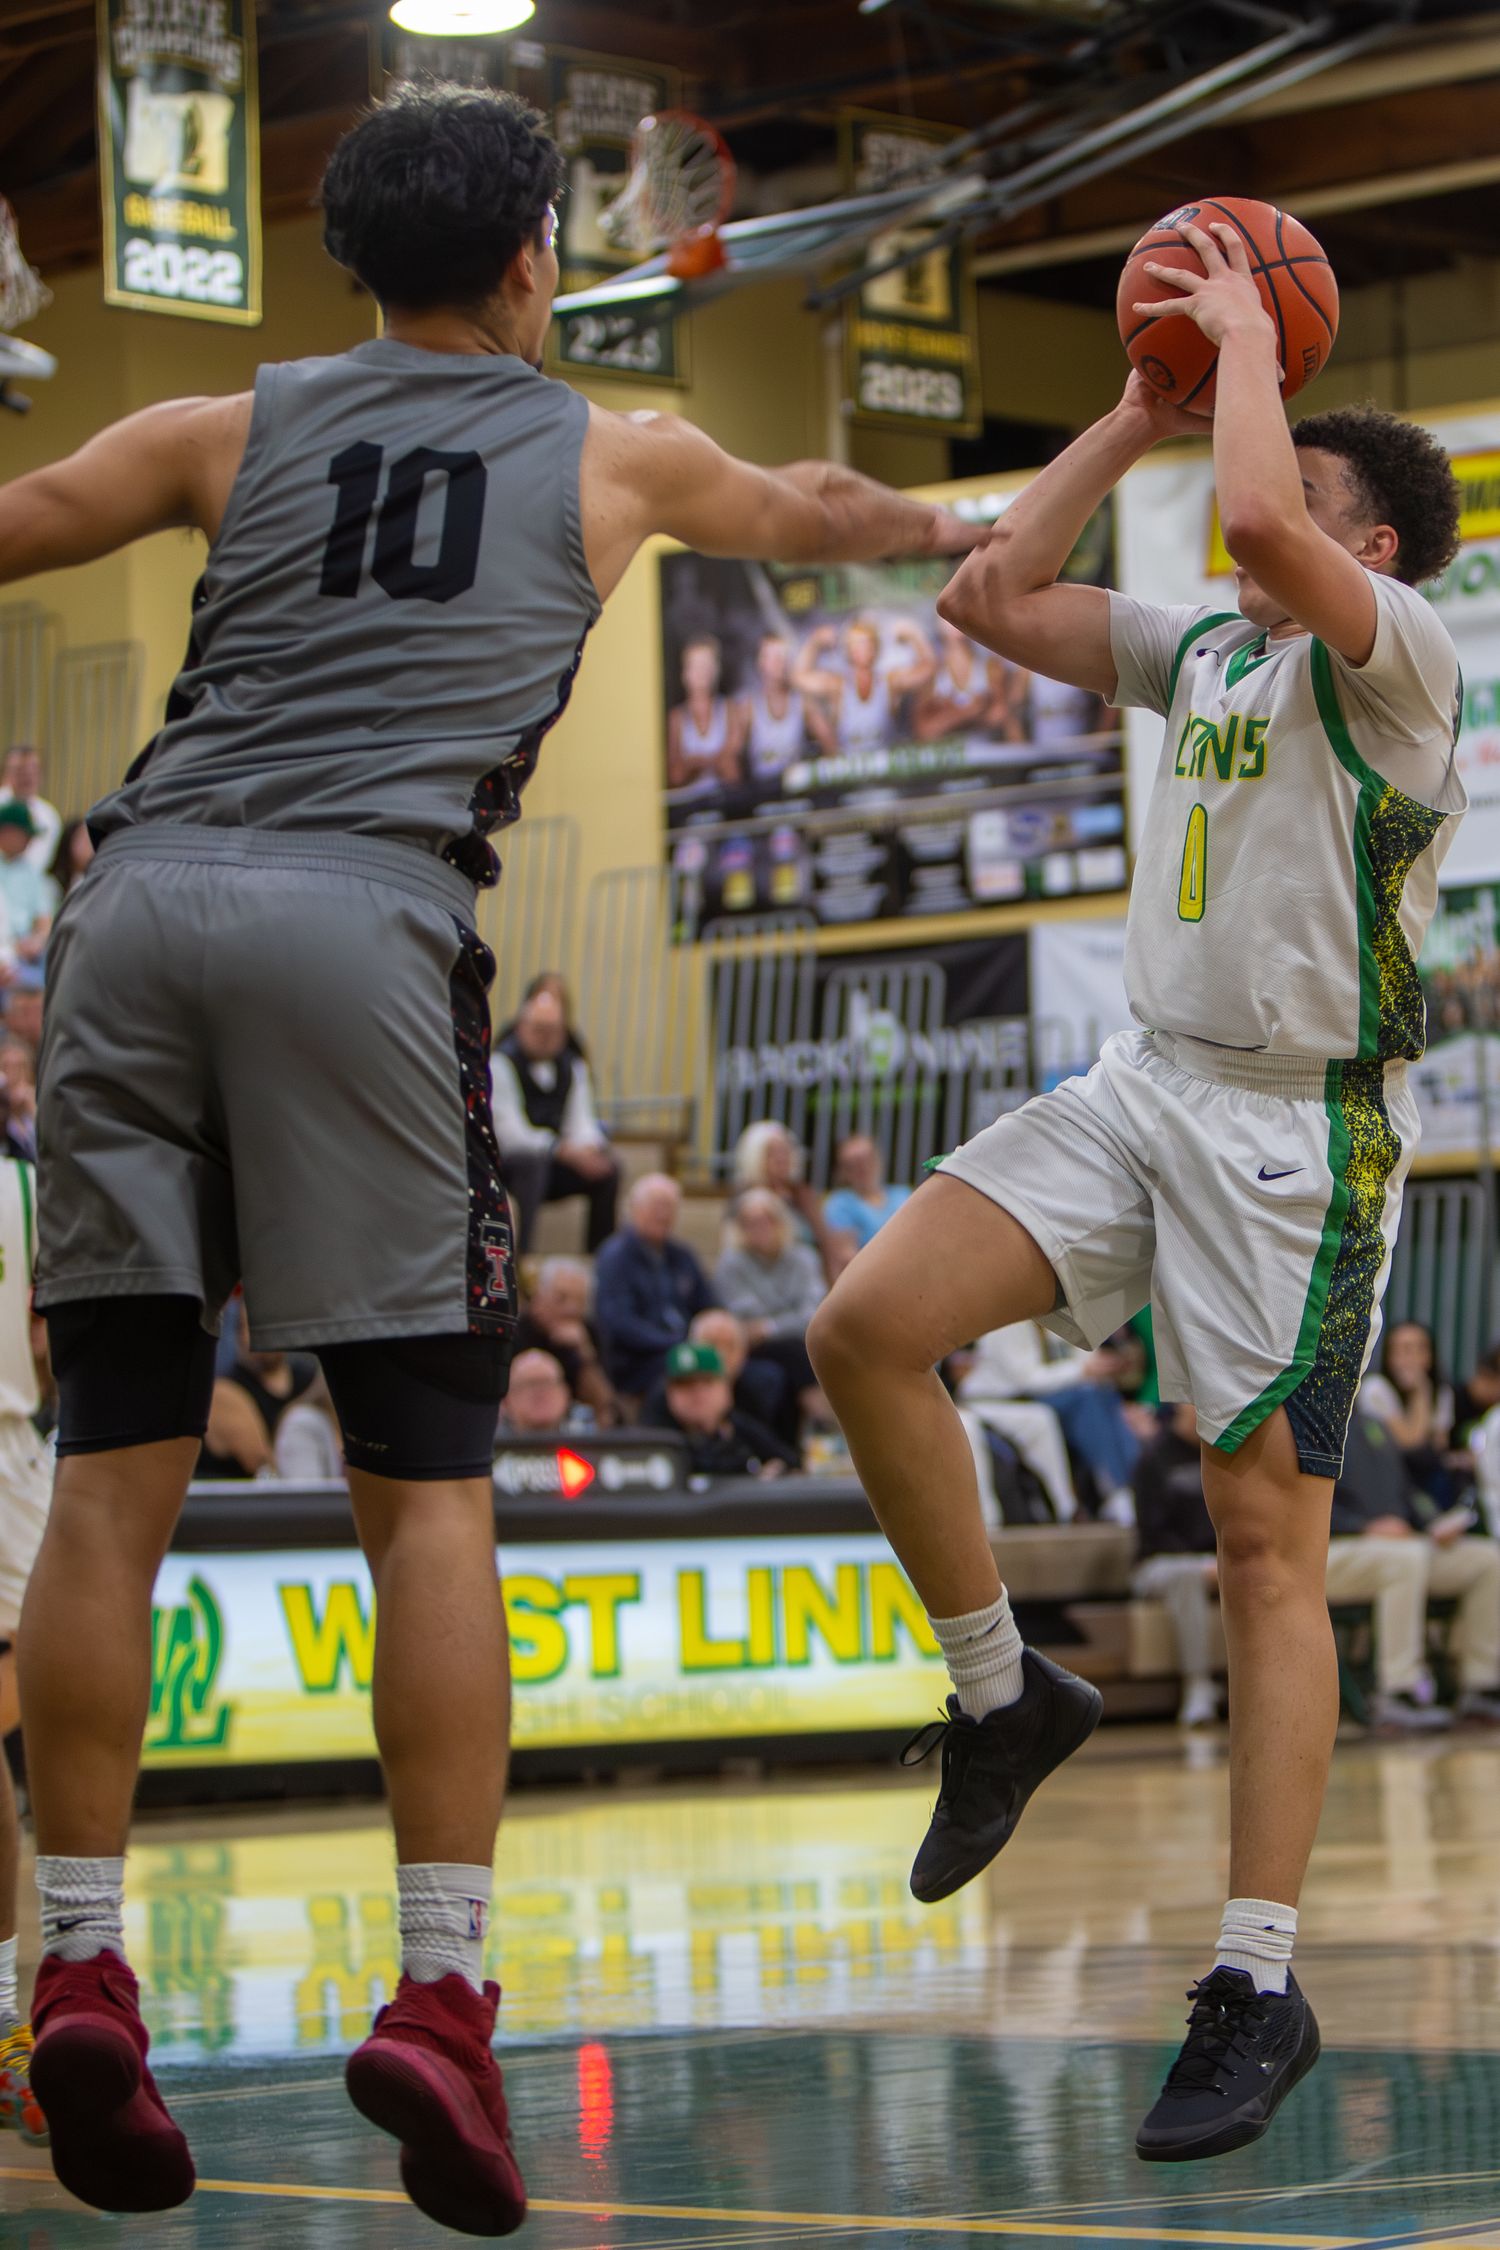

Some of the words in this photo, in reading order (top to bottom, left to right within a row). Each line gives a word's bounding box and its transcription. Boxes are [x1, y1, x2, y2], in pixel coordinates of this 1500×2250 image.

[124, 237, 243, 305] 2022
[318, 440, 488, 604] 10
[276, 1570, 642, 1694] WST
